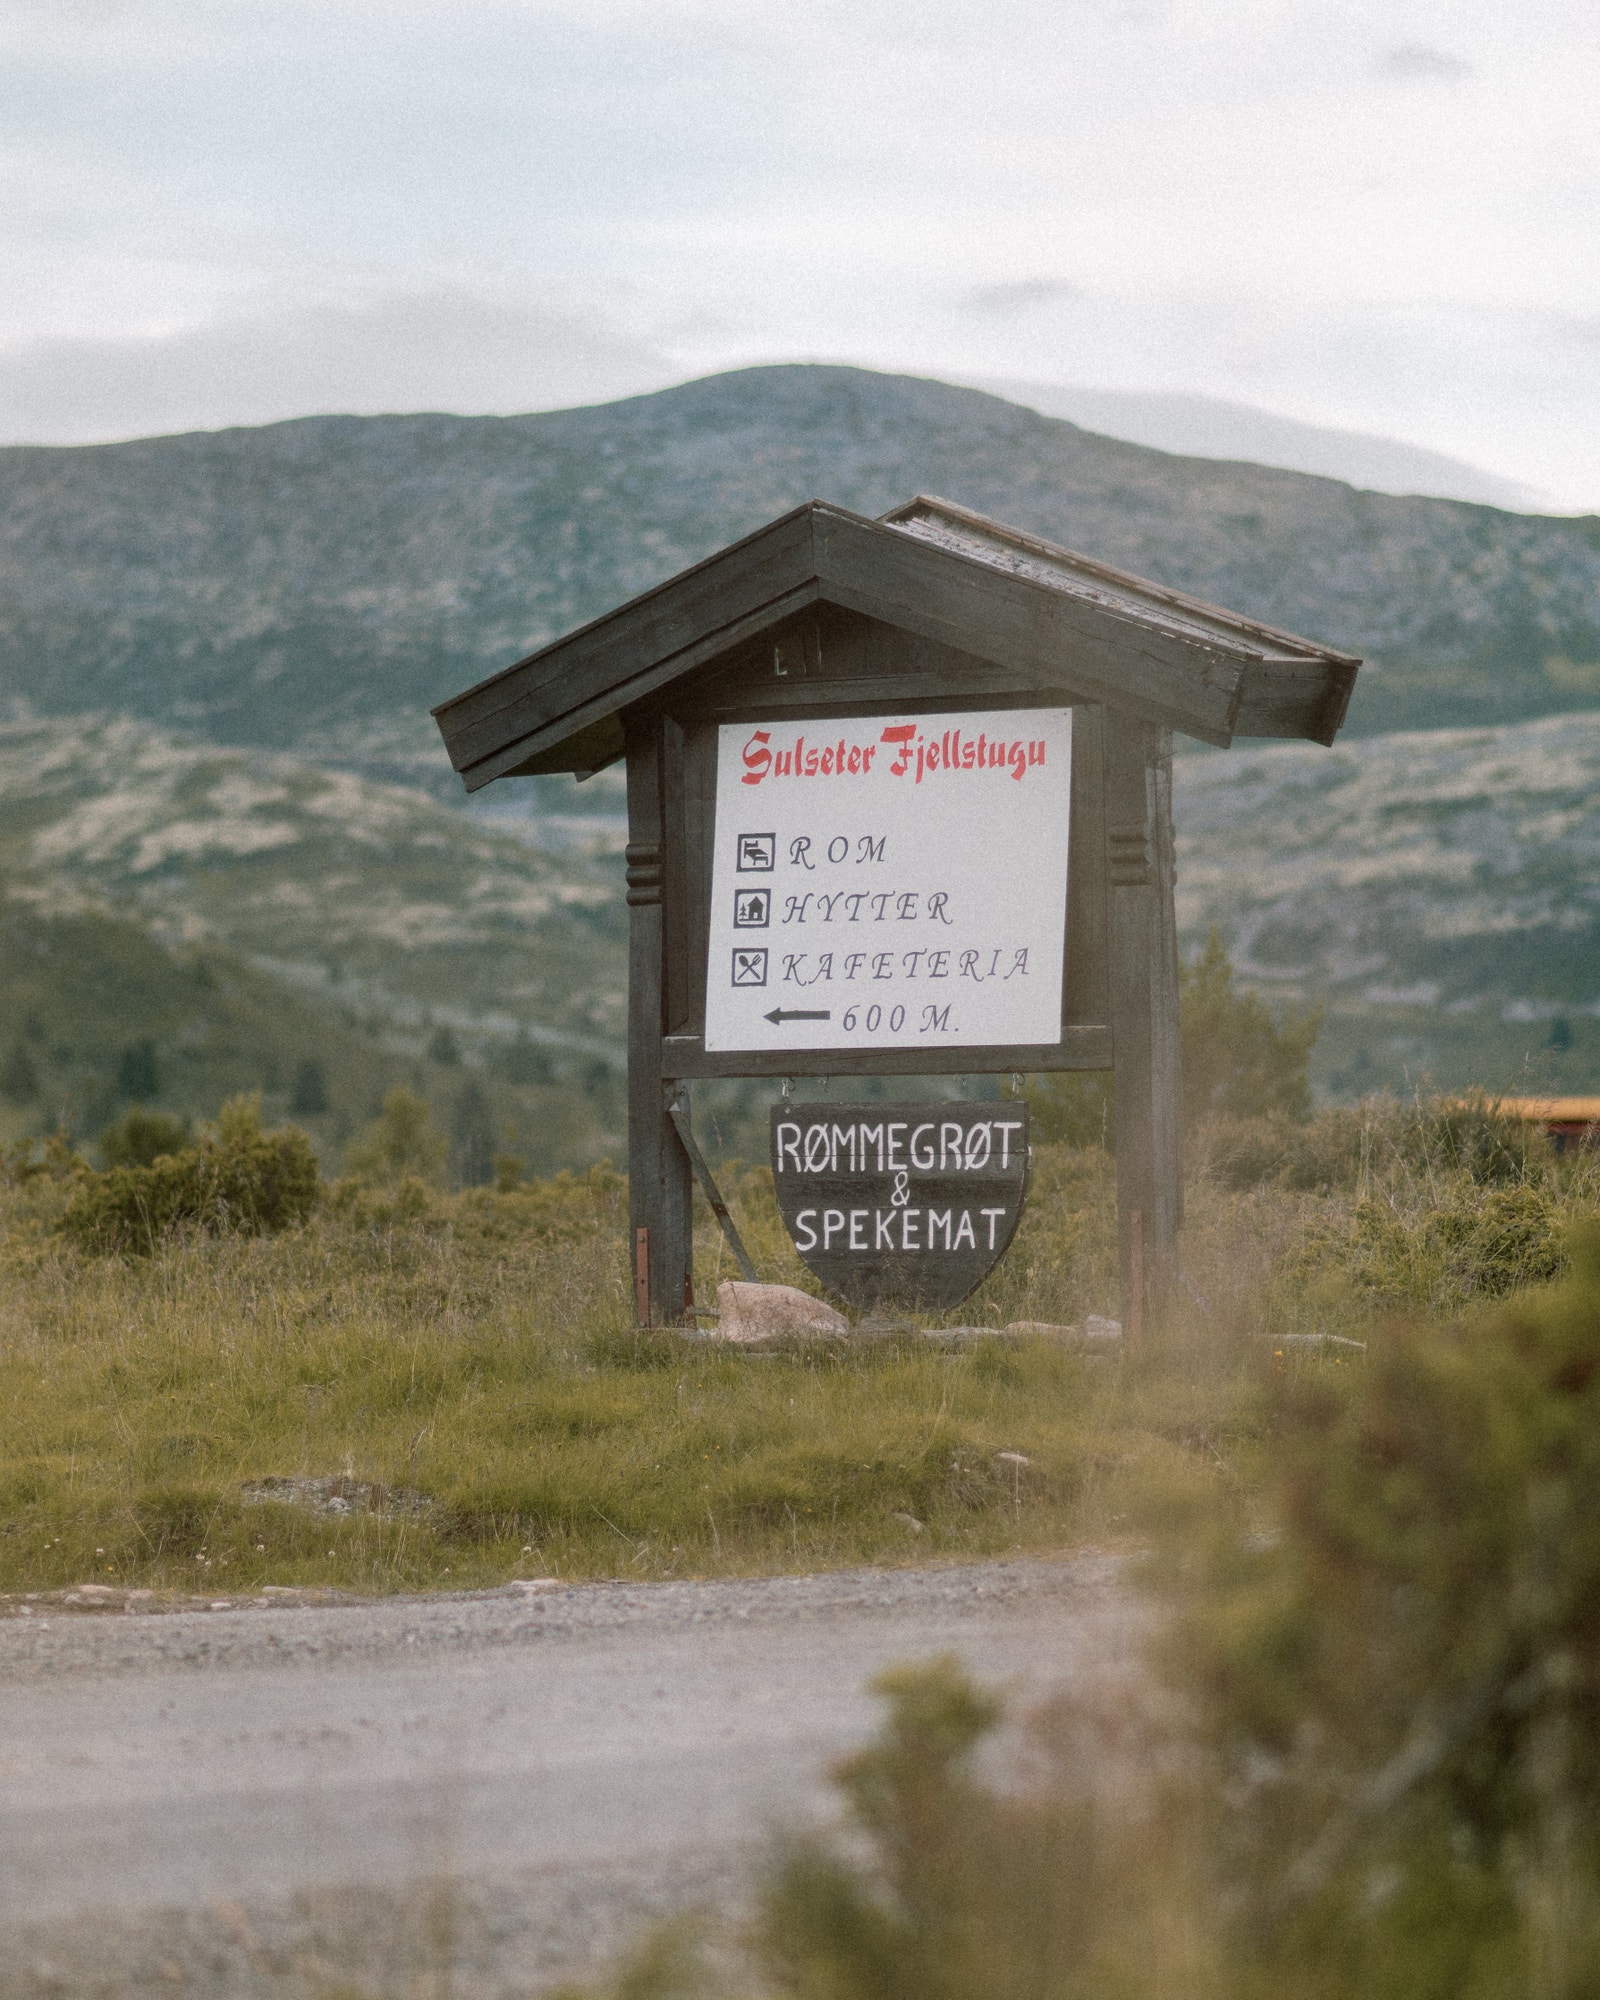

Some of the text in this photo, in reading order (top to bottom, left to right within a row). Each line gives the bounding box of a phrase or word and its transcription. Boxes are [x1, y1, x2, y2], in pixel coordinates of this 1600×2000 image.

[741, 724, 1046, 785] Sulseter Fjellstugu
[789, 835, 887, 870] ROM
[782, 891, 953, 925] HYTTER
[782, 948, 1030, 986] KAFETERIA
[843, 1003, 960, 1032] 600 M.
[777, 1121, 1022, 1172] RØMMEGRØT
[891, 1171, 910, 1206] &
[795, 1208, 1006, 1251] SPEKEMAT
